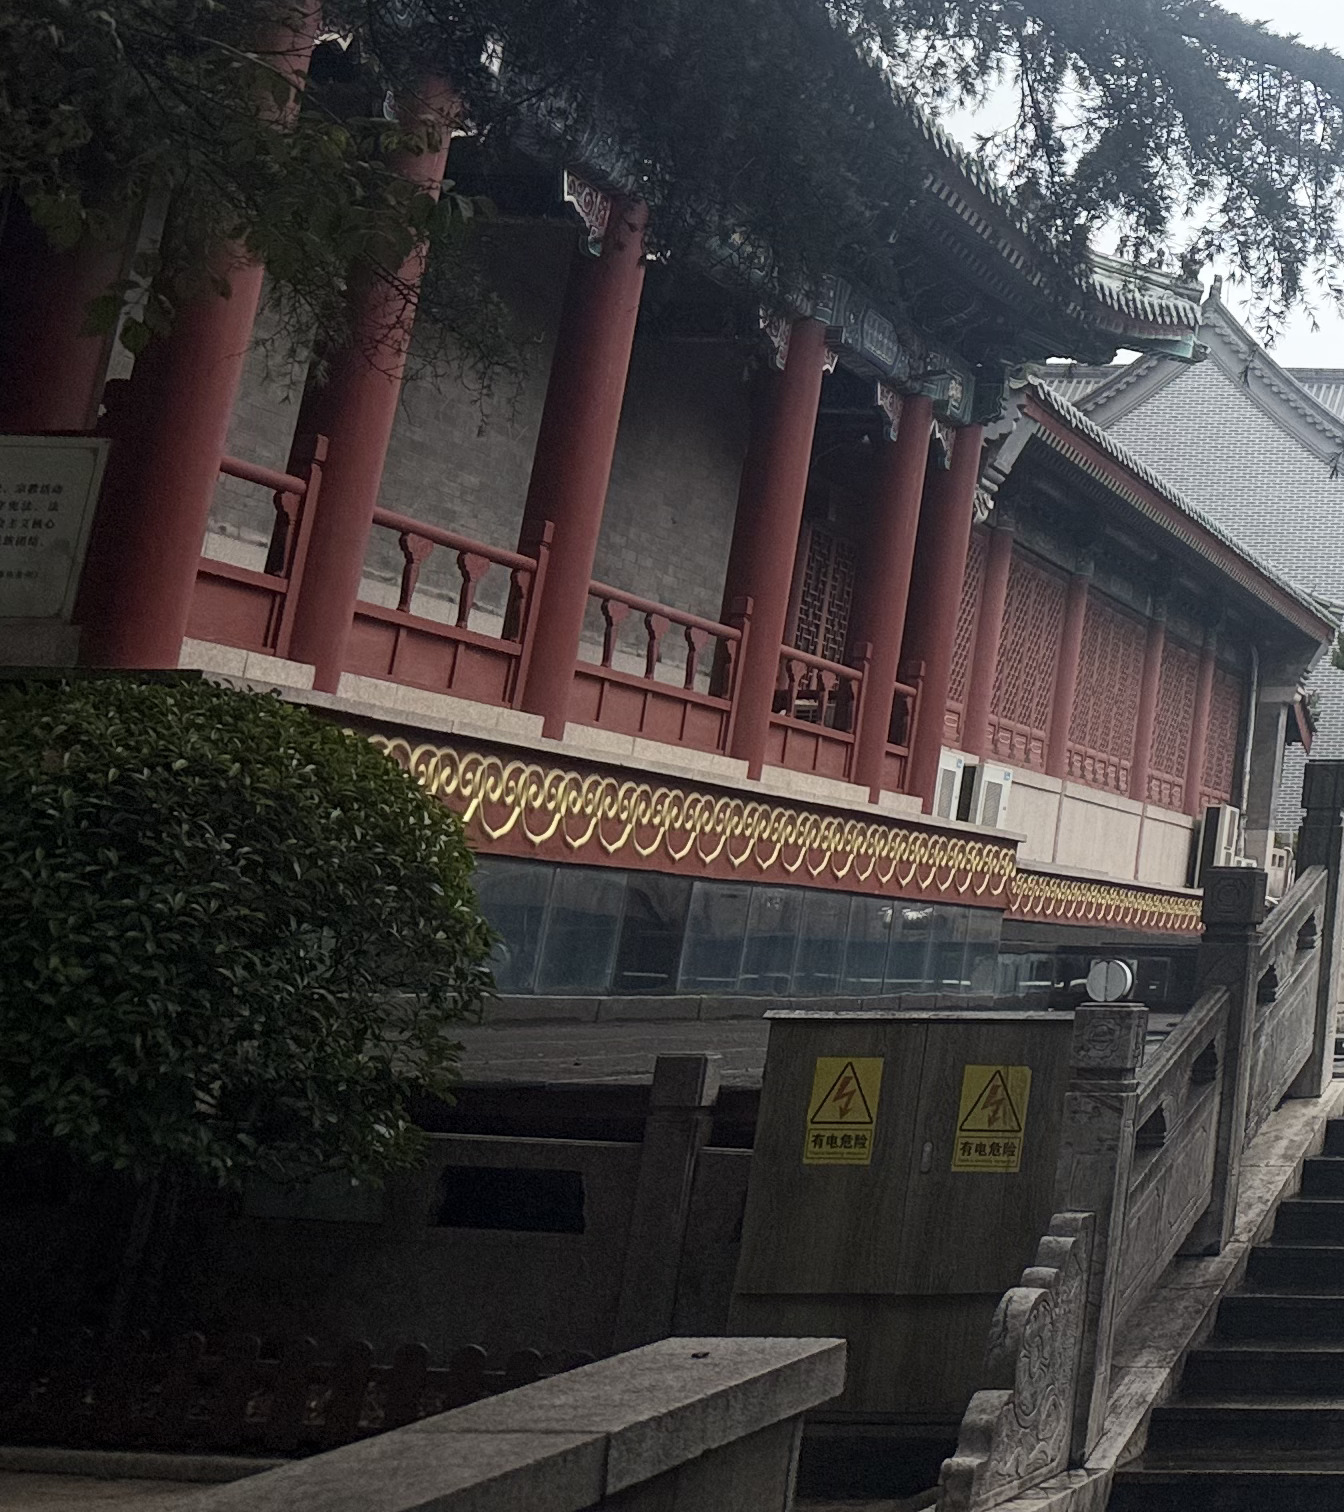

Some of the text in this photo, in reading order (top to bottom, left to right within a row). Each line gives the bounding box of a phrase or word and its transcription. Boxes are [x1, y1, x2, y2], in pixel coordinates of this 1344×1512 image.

[811, 1133, 868, 1149] 有电危险
[959, 1141, 1017, 1157] 有电危险
